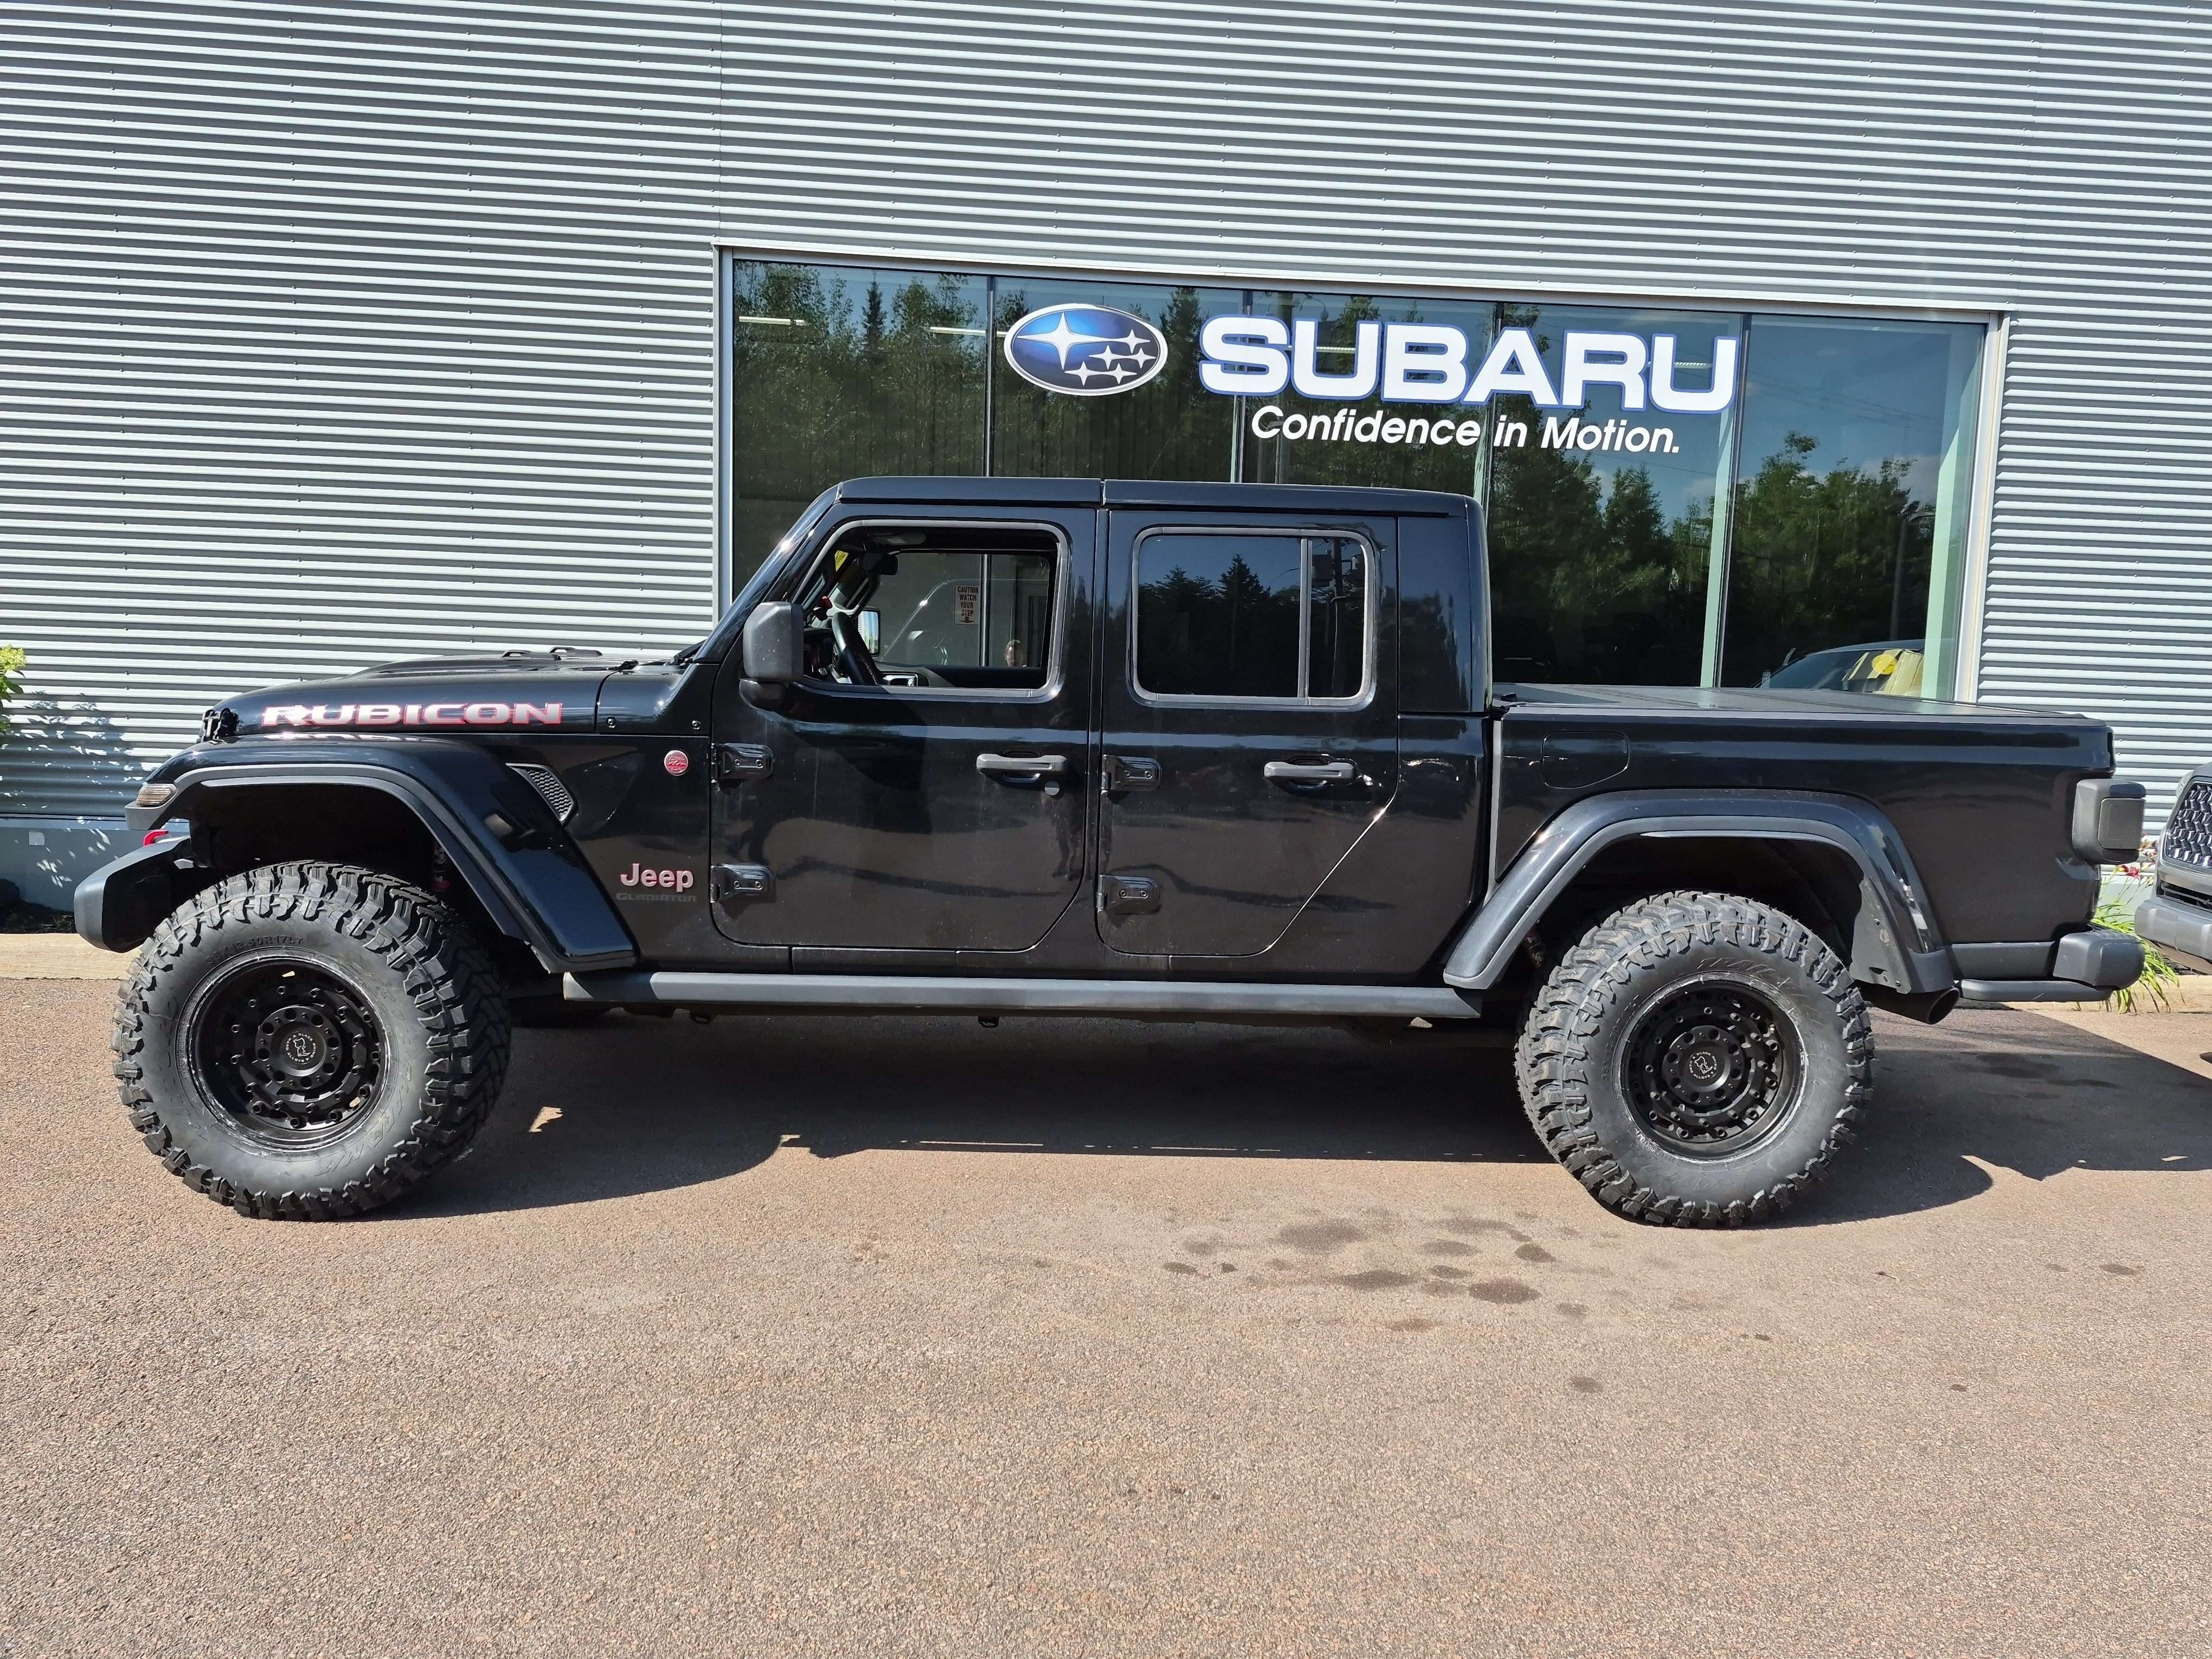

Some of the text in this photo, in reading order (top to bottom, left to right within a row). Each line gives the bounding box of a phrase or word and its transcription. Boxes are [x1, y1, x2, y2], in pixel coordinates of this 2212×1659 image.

[1199, 314, 1739, 414] SUBARU
[1251, 405, 1680, 453] Confidence in Motion.
[261, 703, 562, 726] RUBICON
[620, 863, 694, 892] Jeep
[616, 892, 698, 903] GLADIATOR
